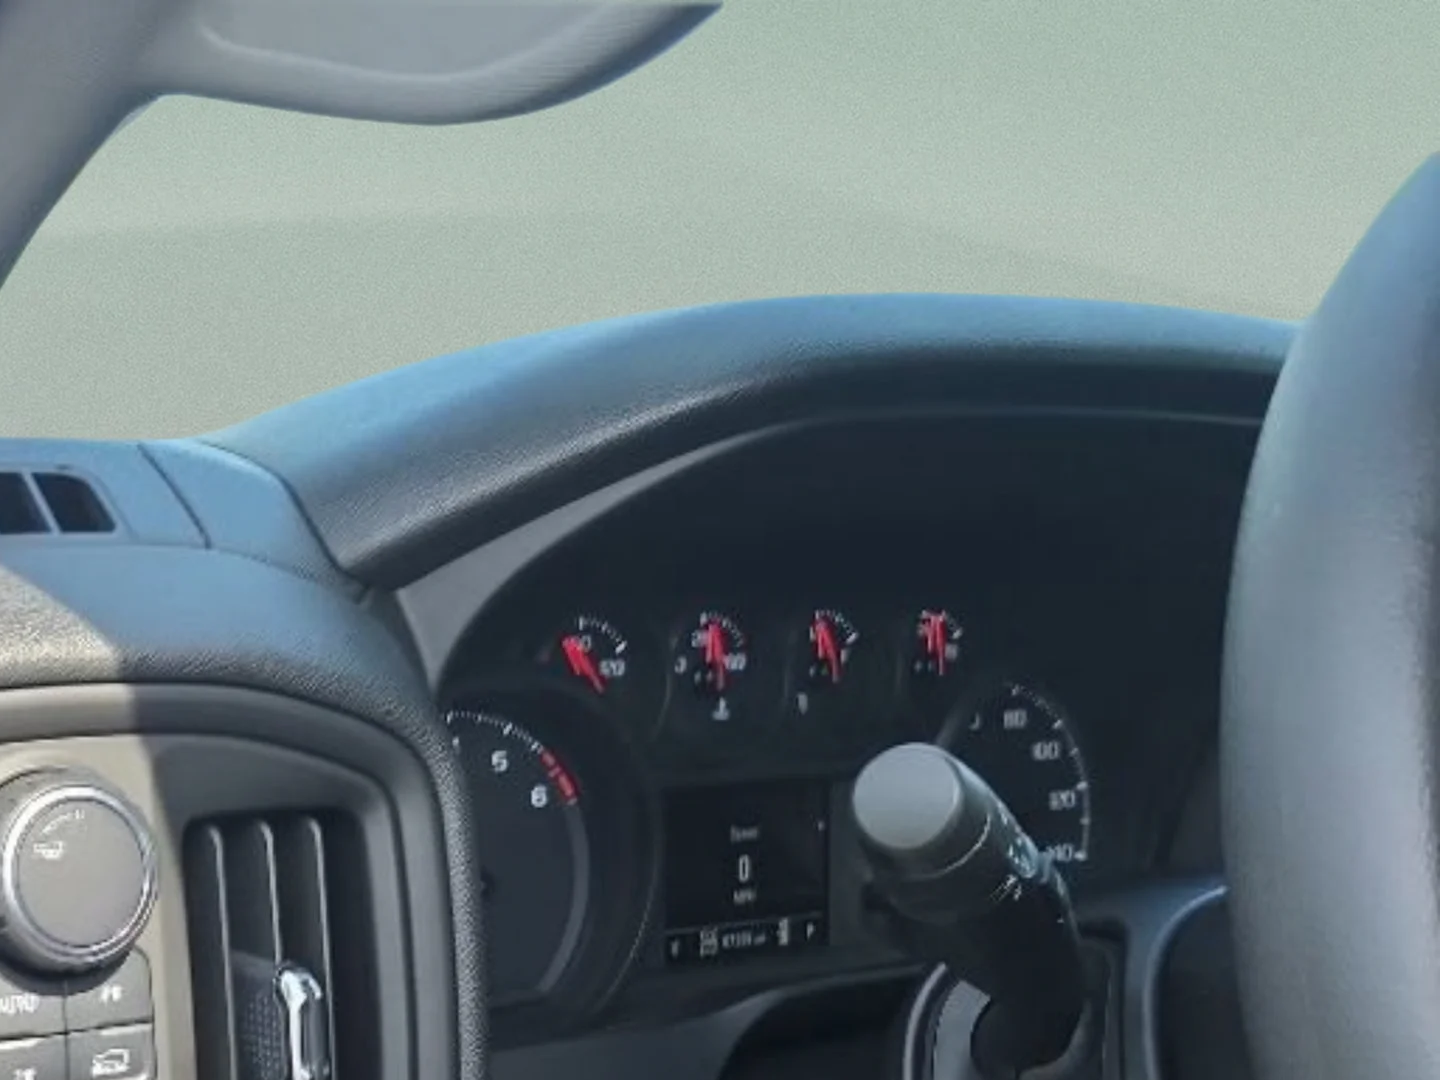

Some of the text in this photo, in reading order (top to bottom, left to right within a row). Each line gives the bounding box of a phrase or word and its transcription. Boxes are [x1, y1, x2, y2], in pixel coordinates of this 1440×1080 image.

[491, 750, 509, 772] 5
[530, 784, 548, 809] 6
[738, 854, 751, 883] 0
